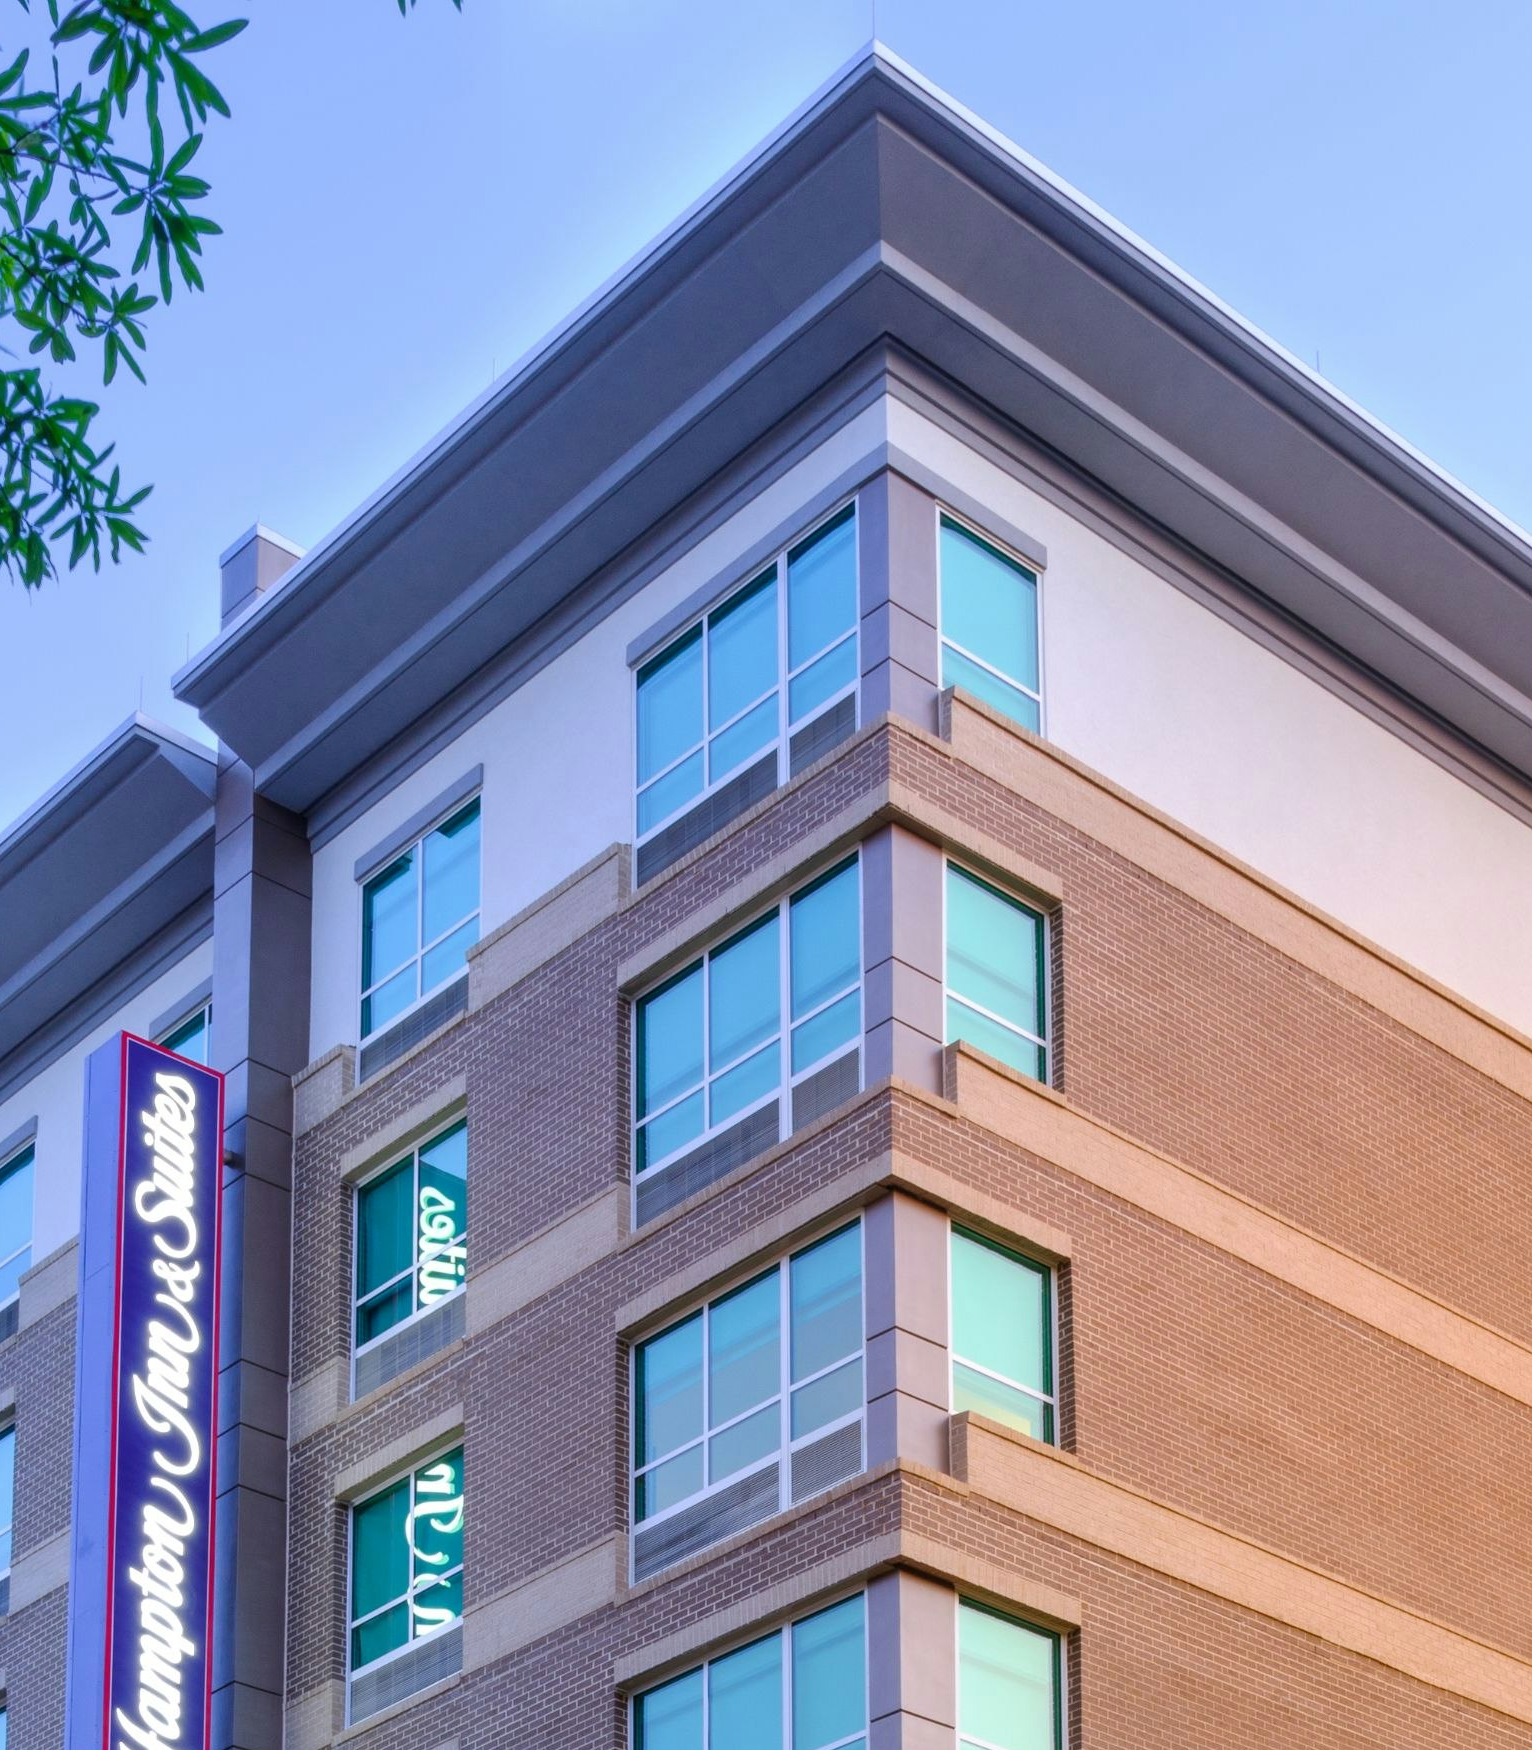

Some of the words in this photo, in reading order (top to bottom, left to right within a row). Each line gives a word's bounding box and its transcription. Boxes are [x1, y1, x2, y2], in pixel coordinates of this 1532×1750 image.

[134, 1073, 198, 1259] Suites
[152, 1259, 201, 1304] &
[133, 1294, 201, 1477] Inn
